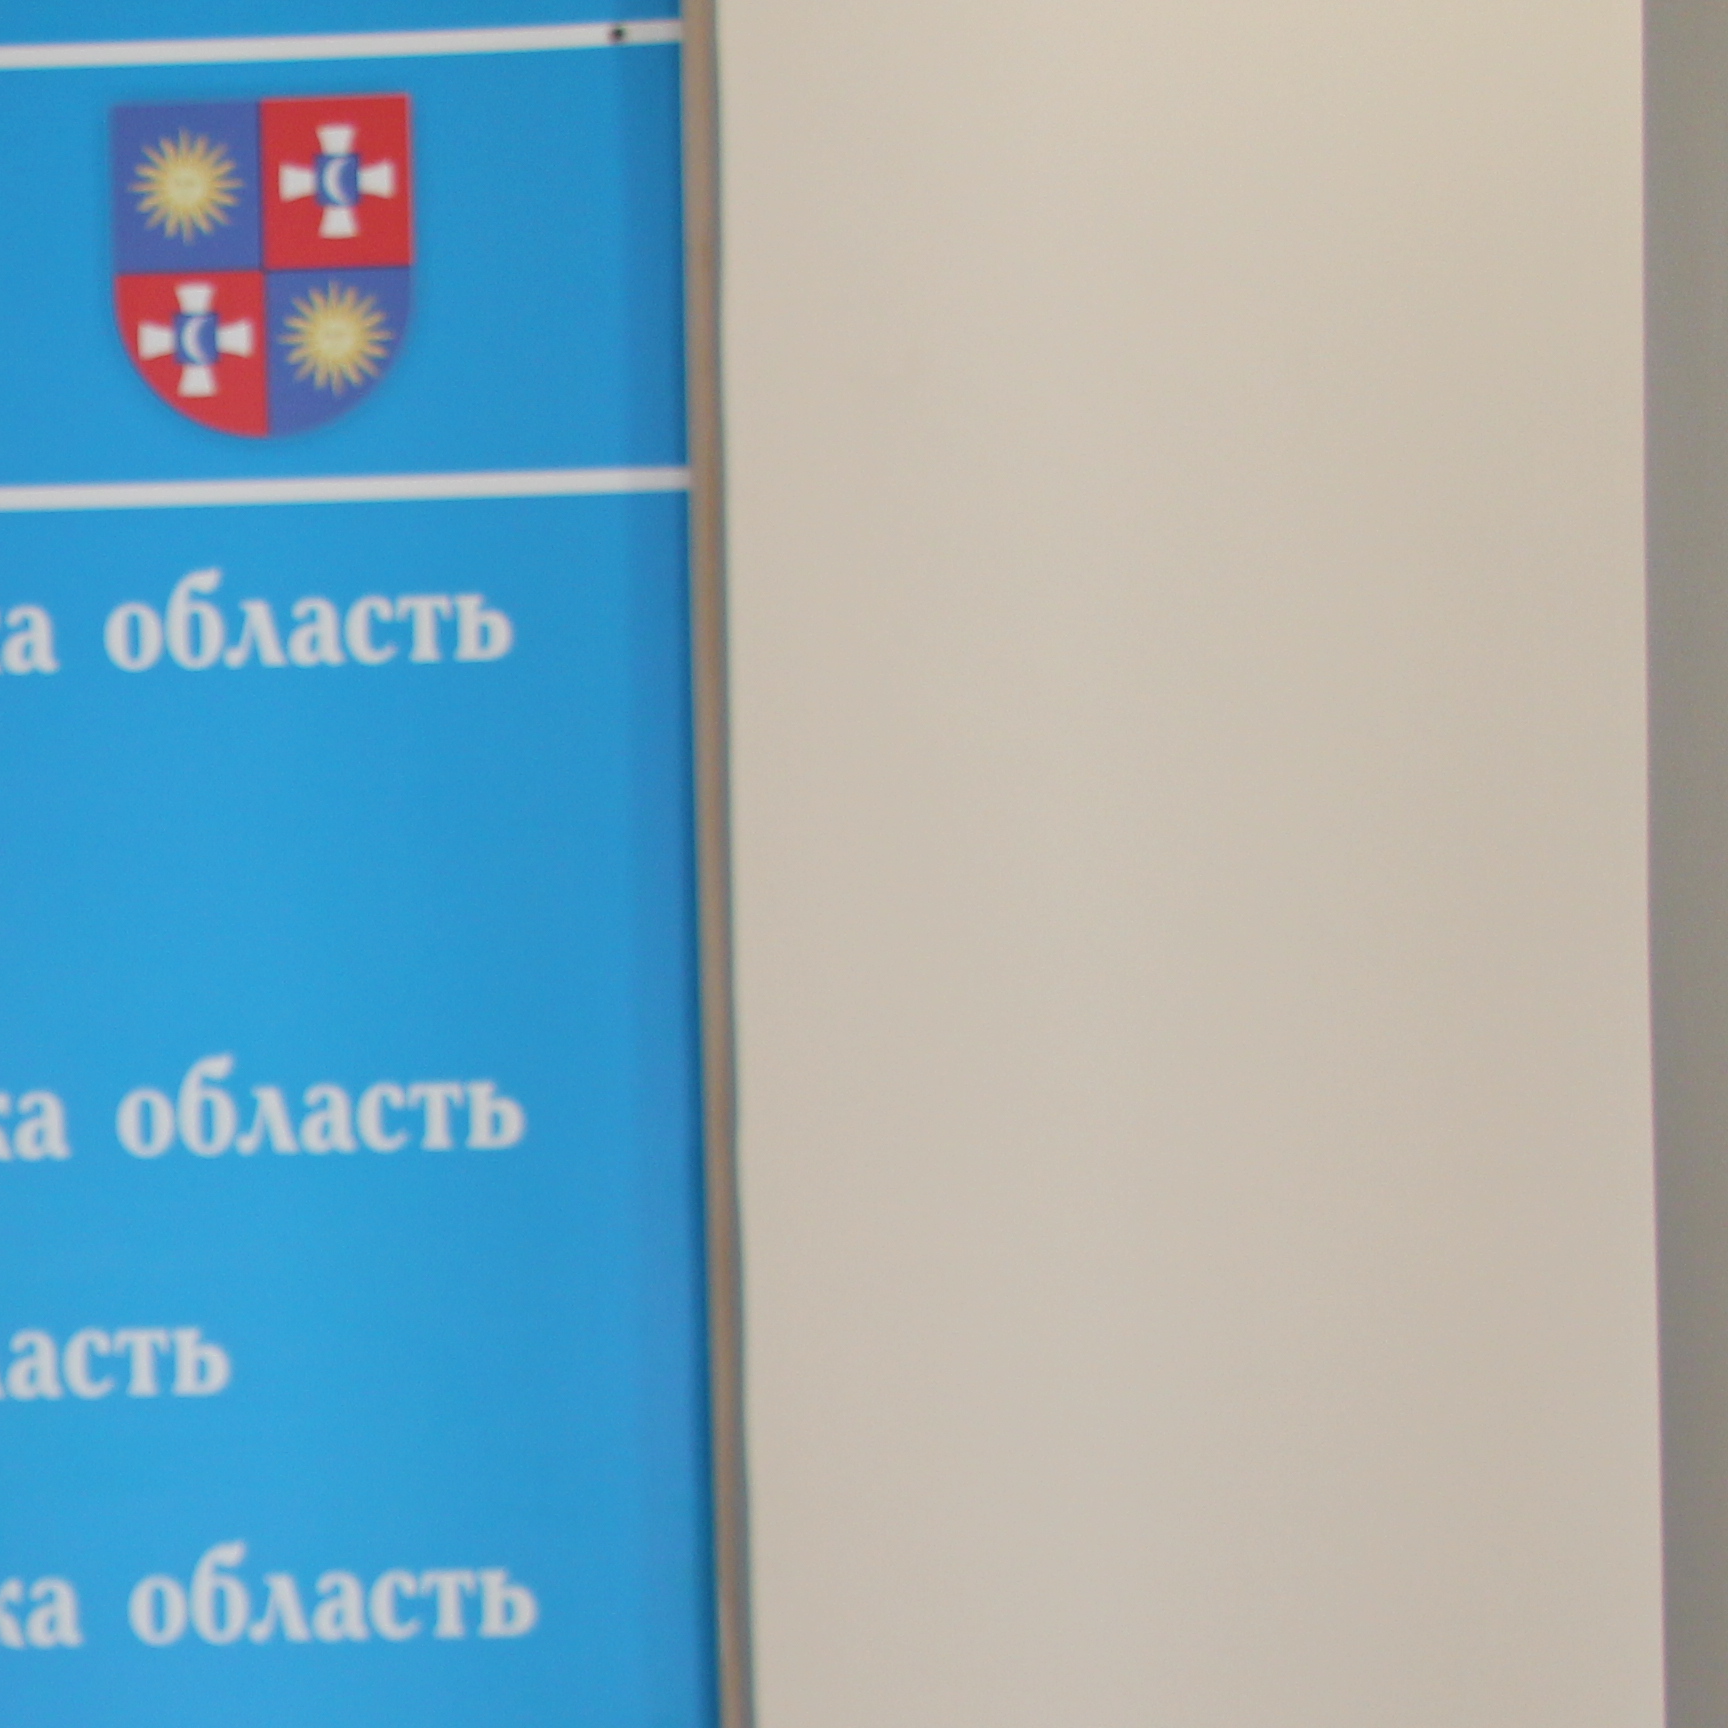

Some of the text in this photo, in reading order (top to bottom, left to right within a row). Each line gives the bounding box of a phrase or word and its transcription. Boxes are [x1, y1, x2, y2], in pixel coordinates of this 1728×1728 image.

[106, 569, 512, 670] область
[119, 1055, 524, 1156] область
[131, 1542, 537, 1644] область
